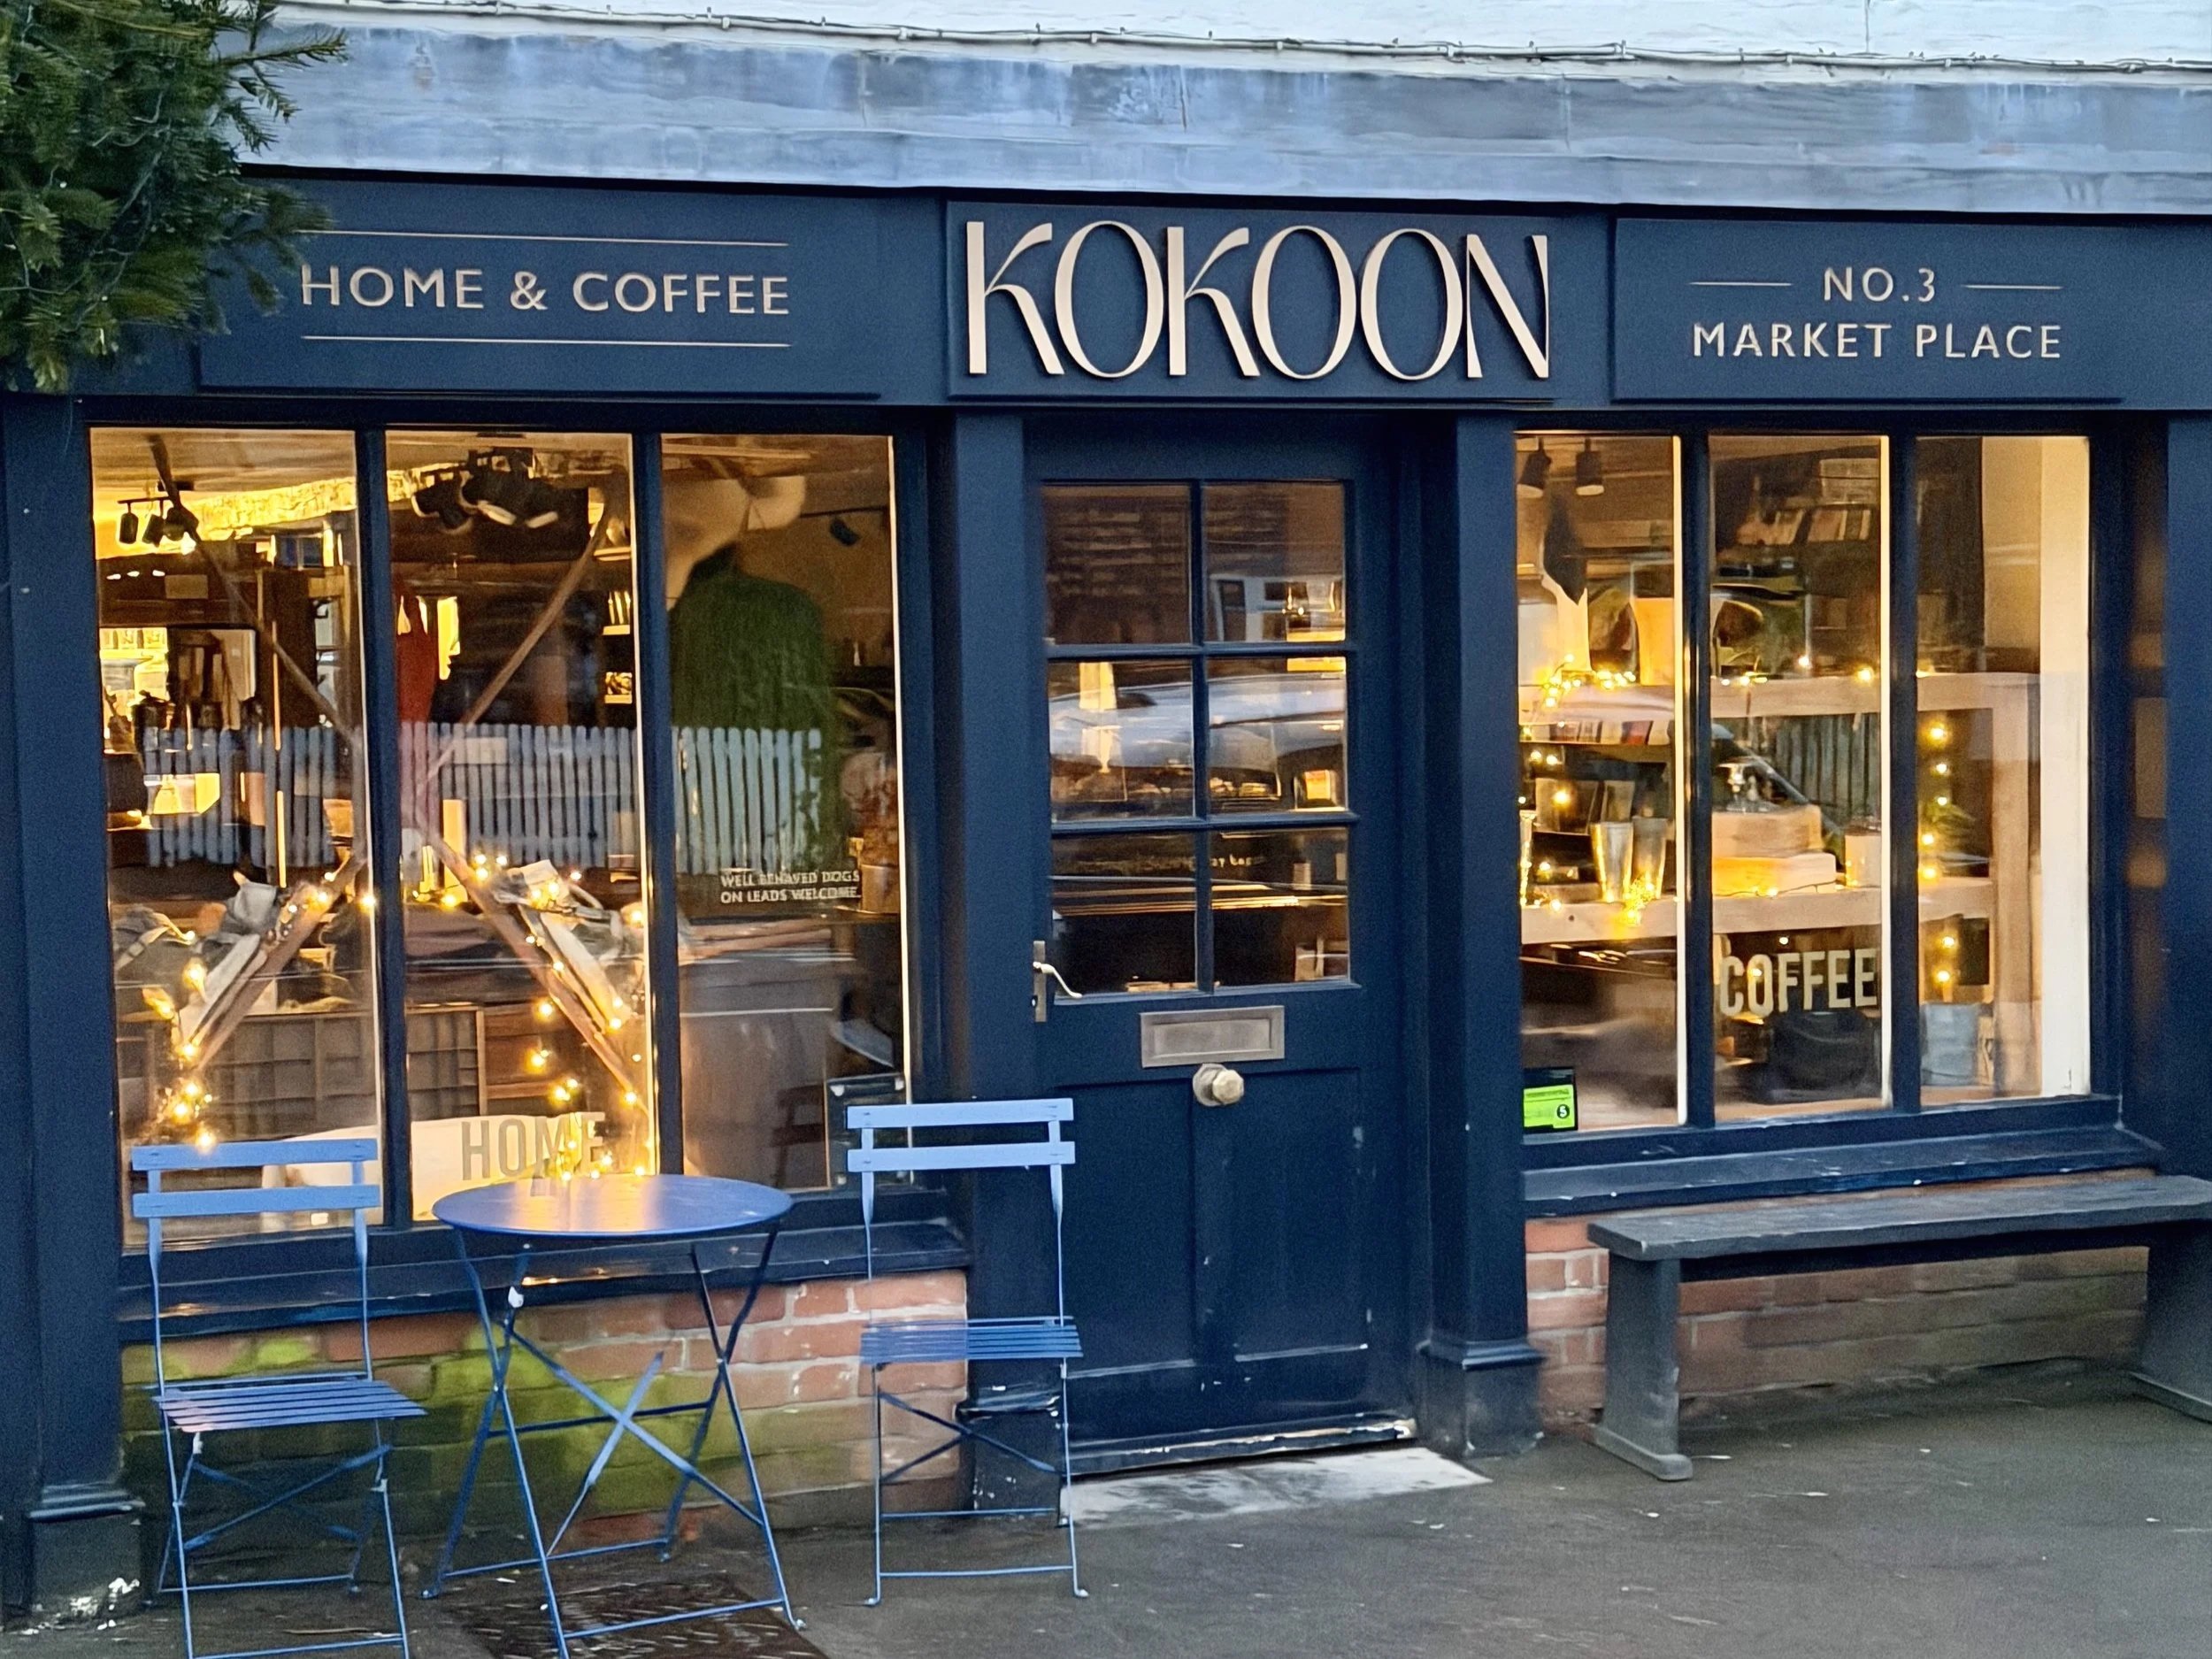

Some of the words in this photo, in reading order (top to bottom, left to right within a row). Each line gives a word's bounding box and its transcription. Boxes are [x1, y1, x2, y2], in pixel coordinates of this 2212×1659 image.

[301, 265, 484, 309] HOME
[510, 270, 547, 311] &
[572, 272, 789, 315] COFFEE
[966, 219, 1549, 380] KOKOON
[1824, 267, 1937, 303] NO.3
[1693, 322, 1892, 358] MARKET
[1916, 324, 2062, 359] PLACE
[720, 873, 755, 887] WELL
[821, 870, 860, 882] DOGS
[720, 891, 743, 903] ON
[747, 890, 787, 902] LEADS
[1719, 948, 1878, 1018] COFFEE
